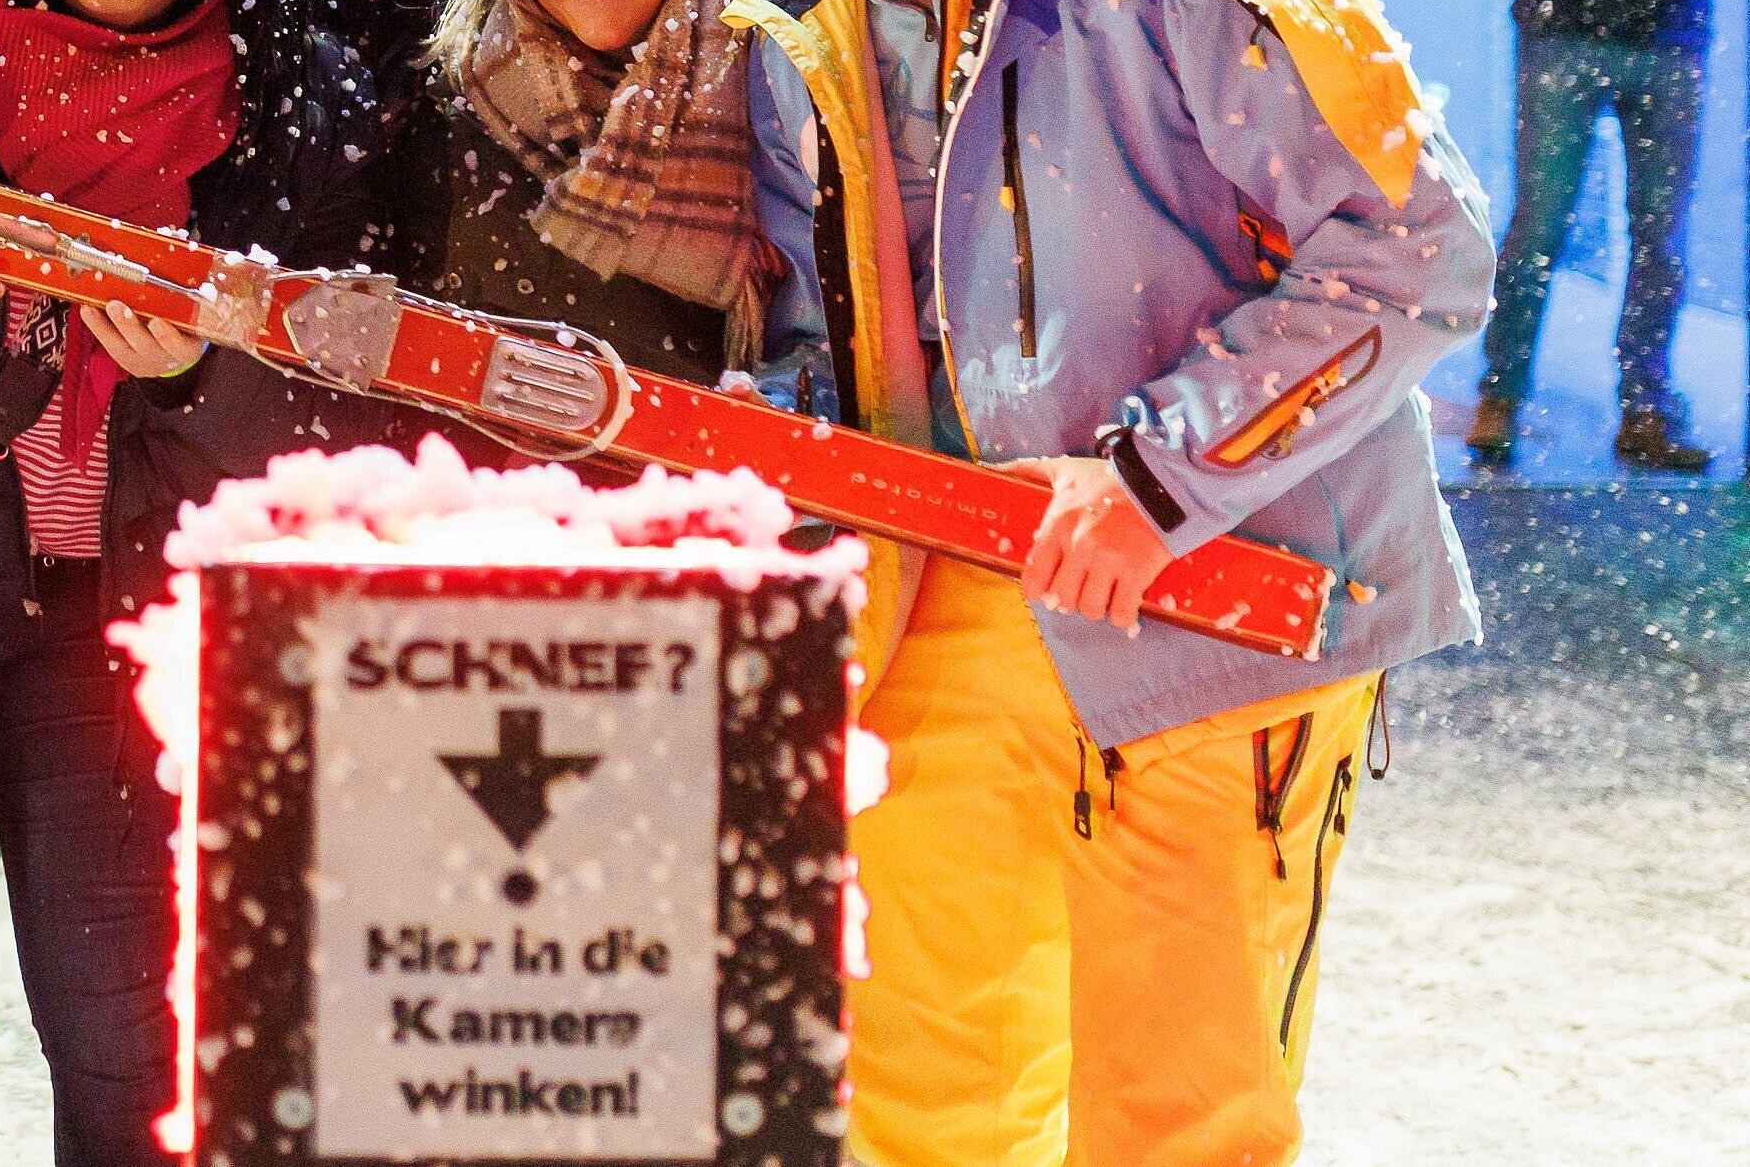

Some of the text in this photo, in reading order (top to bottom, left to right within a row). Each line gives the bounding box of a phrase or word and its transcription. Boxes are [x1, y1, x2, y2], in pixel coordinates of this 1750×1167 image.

[365, 924, 671, 975] Hier in die
[391, 997, 641, 1045] Kamera
[399, 1068, 640, 1115] winken!
